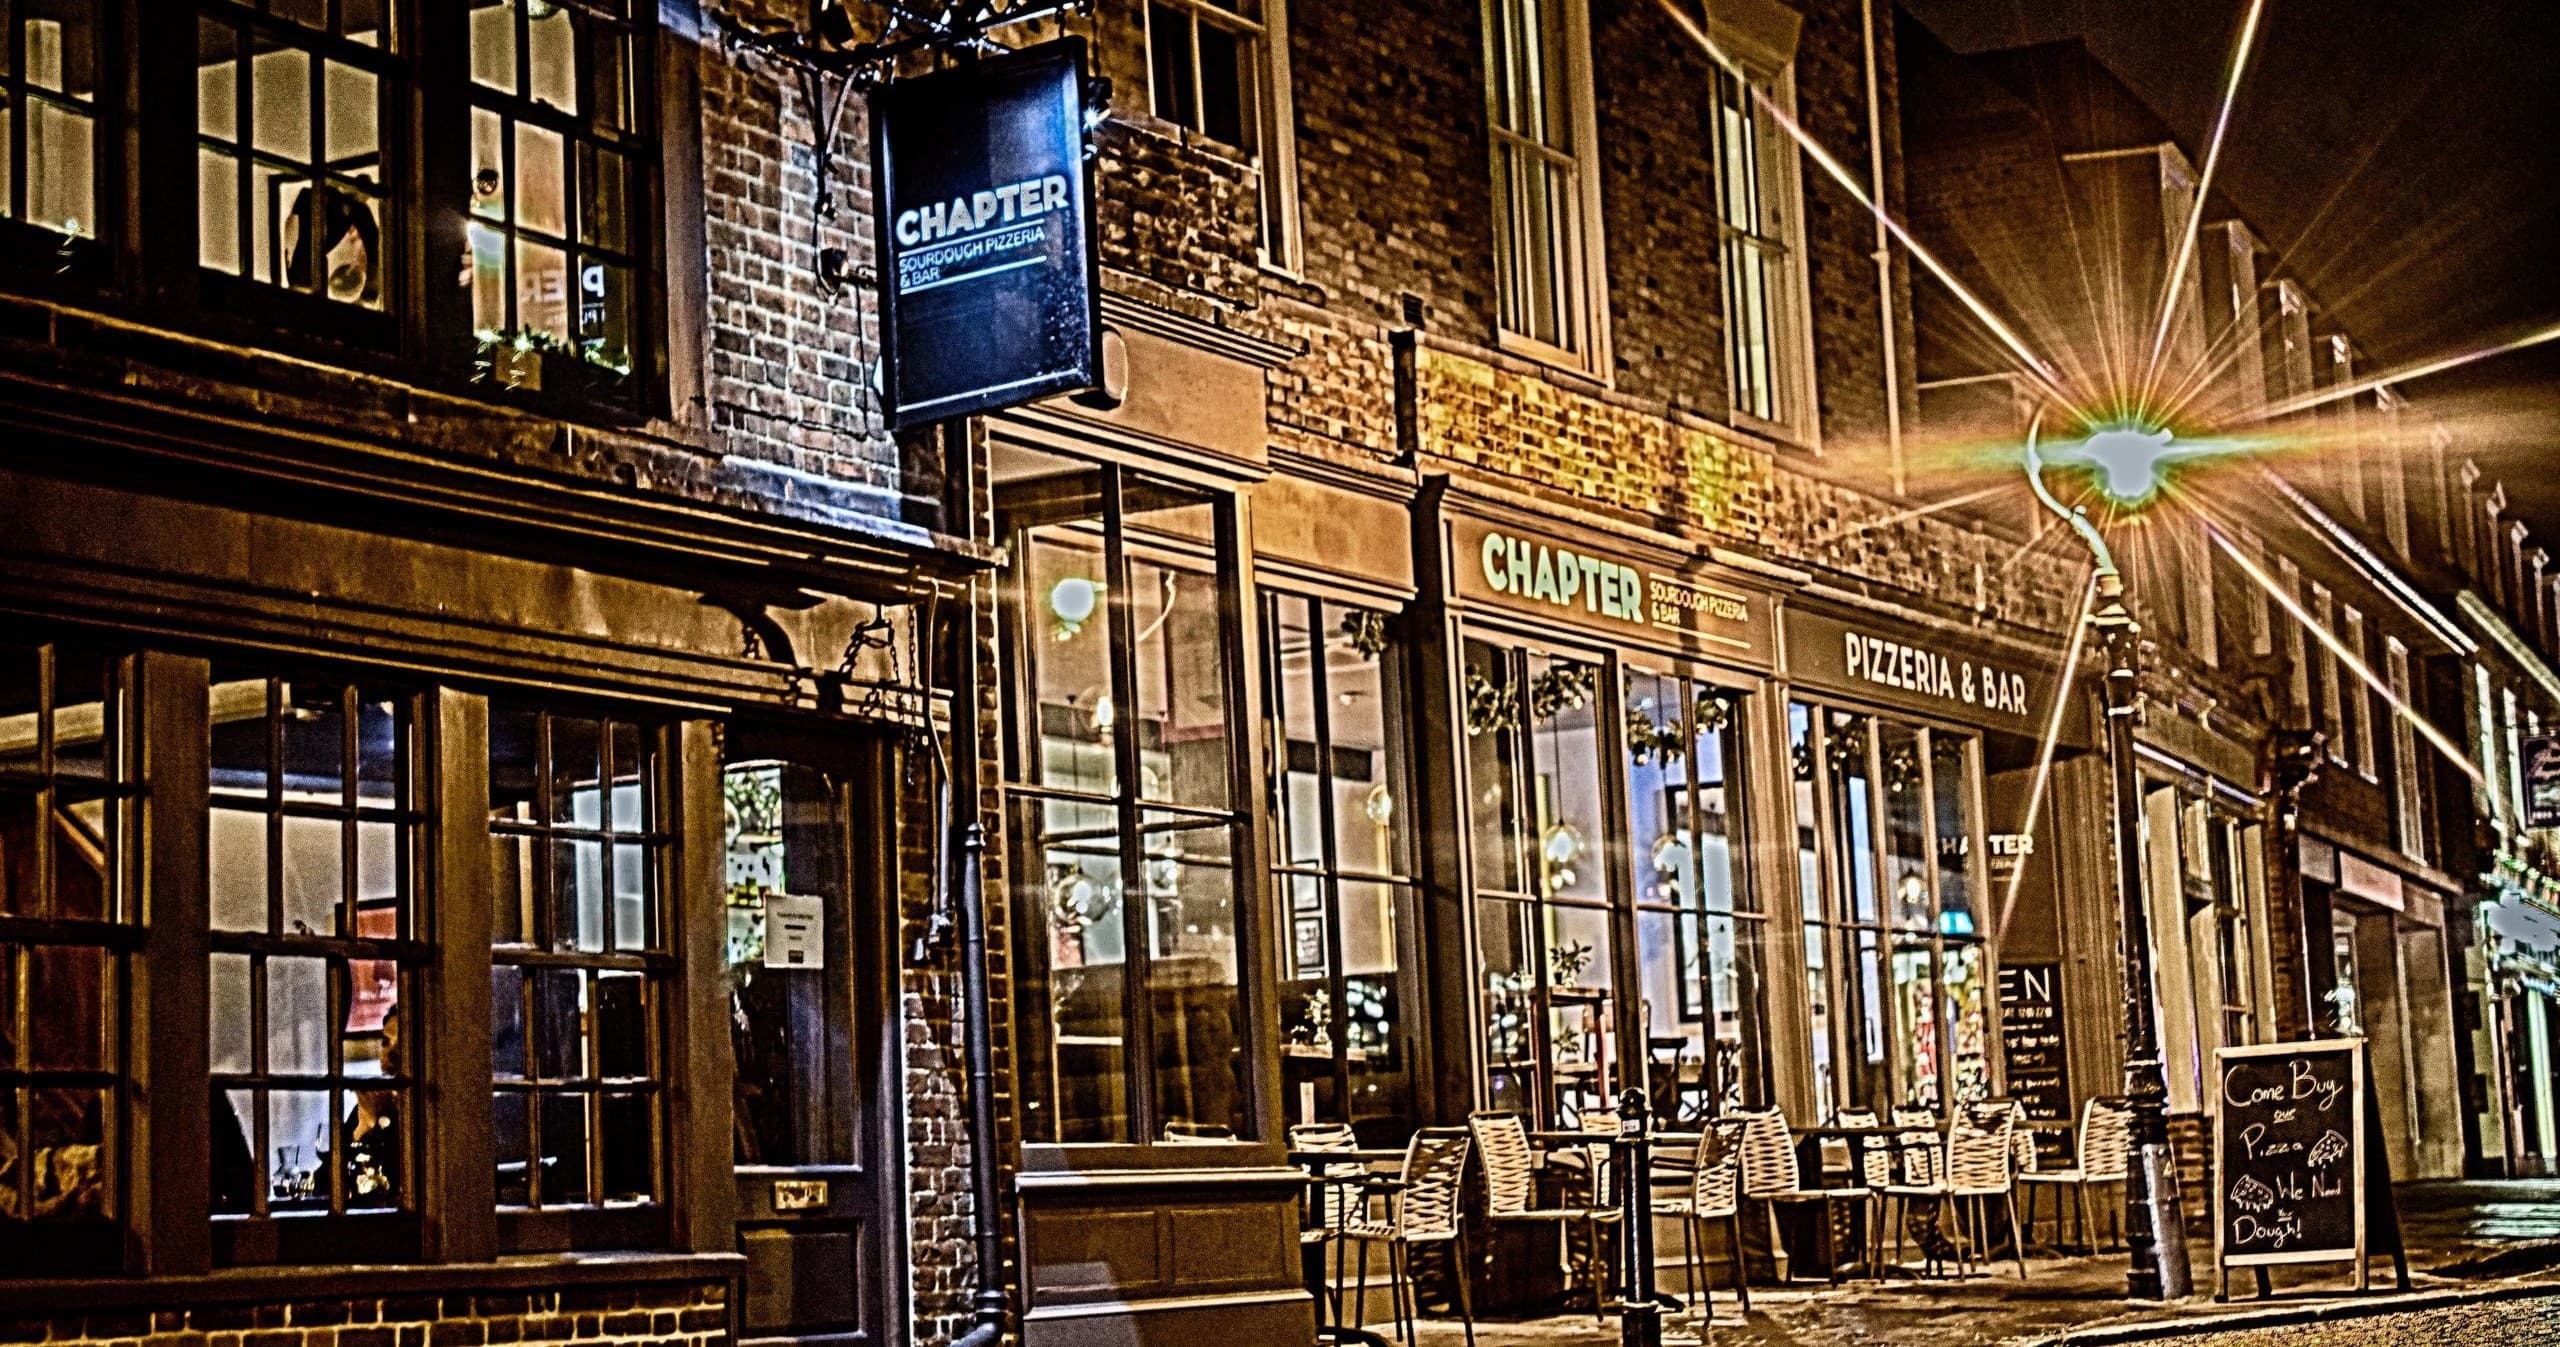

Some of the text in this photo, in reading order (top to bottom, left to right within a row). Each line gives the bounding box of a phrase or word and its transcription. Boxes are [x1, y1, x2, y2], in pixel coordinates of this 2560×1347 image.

[896, 174, 1070, 246] CHAPTER
[899, 226, 1046, 274] SOURDOUGH PIZZERIA
[899, 266, 941, 288] & BAR
[1481, 531, 1645, 624] CHAPTER
[1650, 580, 1749, 622] SOURDOUGH PIZZERIA
[1651, 601, 1681, 625] & BAR
[1845, 631, 2028, 716] PIZZERIA & BAR
[2225, 1059, 2343, 1111] Come Buy
[2239, 1122, 2304, 1160] Pizza
[2276, 1170, 2304, 1200] We
